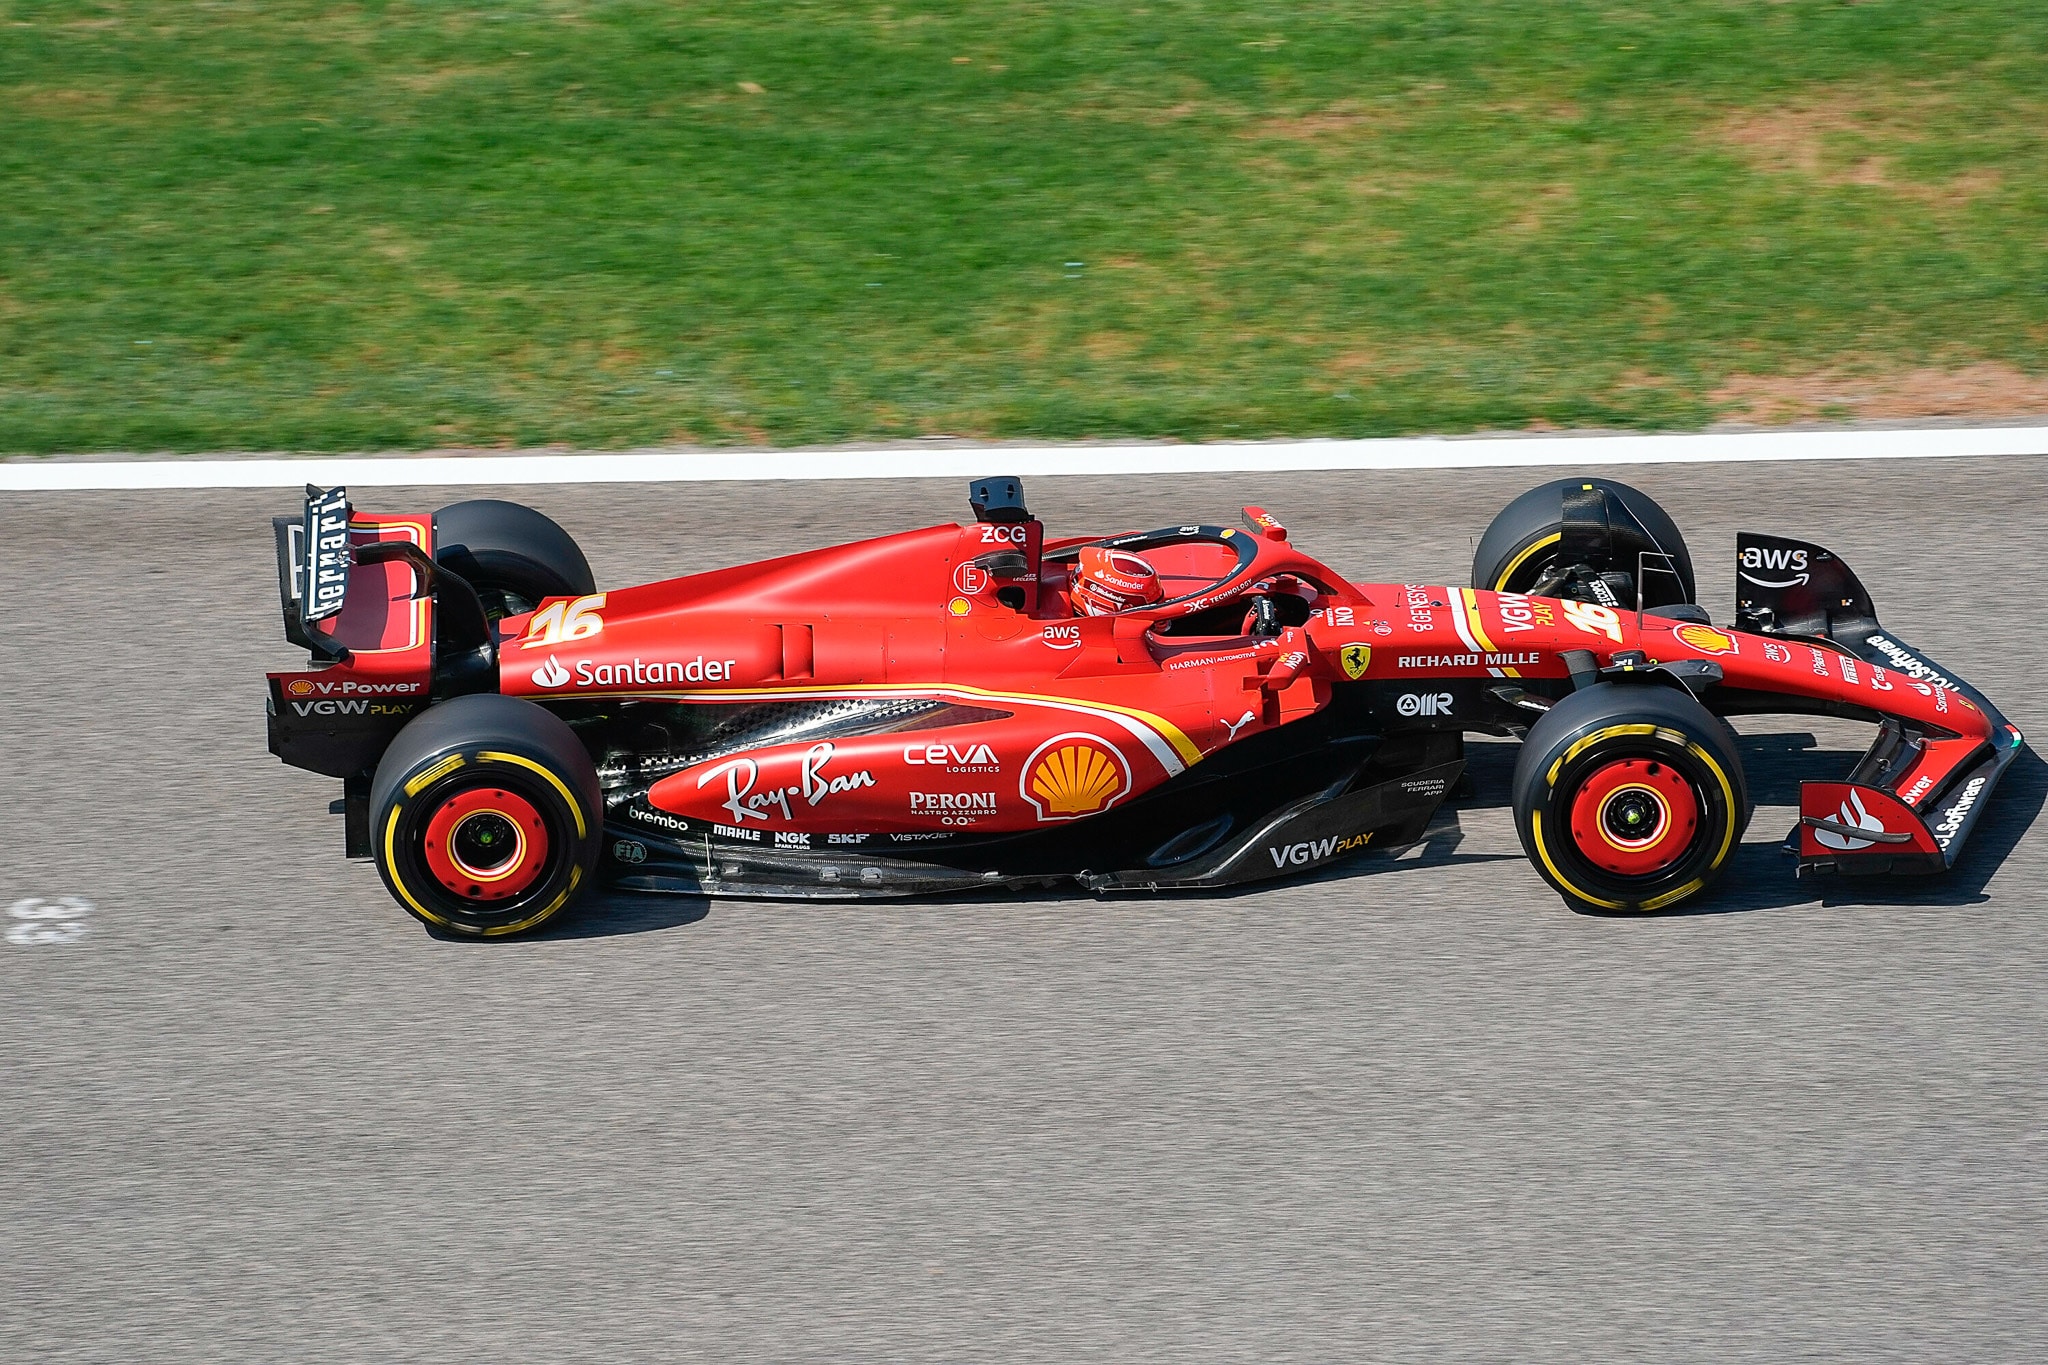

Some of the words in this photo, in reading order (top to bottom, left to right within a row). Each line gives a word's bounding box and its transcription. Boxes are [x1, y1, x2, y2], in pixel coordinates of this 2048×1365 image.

[981, 526, 1026, 543] ZCG
[1742, 547, 1808, 571] aws
[1104, 573, 1144, 590] Santander
[1183, 598, 1210, 614] DXC
[1210, 579, 1252, 604] TECHNOLOGY
[1405, 584, 1433, 623] GENESYS
[520, 592, 607, 650] 16
[1498, 592, 1535, 633] VGW
[1044, 626, 1080, 639] aws
[1169, 657, 1214, 671] HARMAN
[1217, 651, 1256, 662] AUTOMOTIVE
[1398, 654, 1479, 668] RICHARD
[1485, 652, 1540, 665] MILLE
[575, 655, 736, 686] Santander
[316, 681, 420, 694] V-Power
[291, 700, 369, 717] VGW
[371, 704, 413, 715] PLAY
[1401, 779, 1445, 787] SCUDERIA
[909, 791, 997, 809] PERONI
[628, 805, 689, 831] brembo
[941, 817, 976, 826] 0.0%
[713, 823, 761, 841] MAHLE
[774, 832, 811, 845] NGK
[828, 833, 870, 843] SKF
[1269, 836, 1339, 869] VGW
[1336, 832, 1374, 853] PLAY
